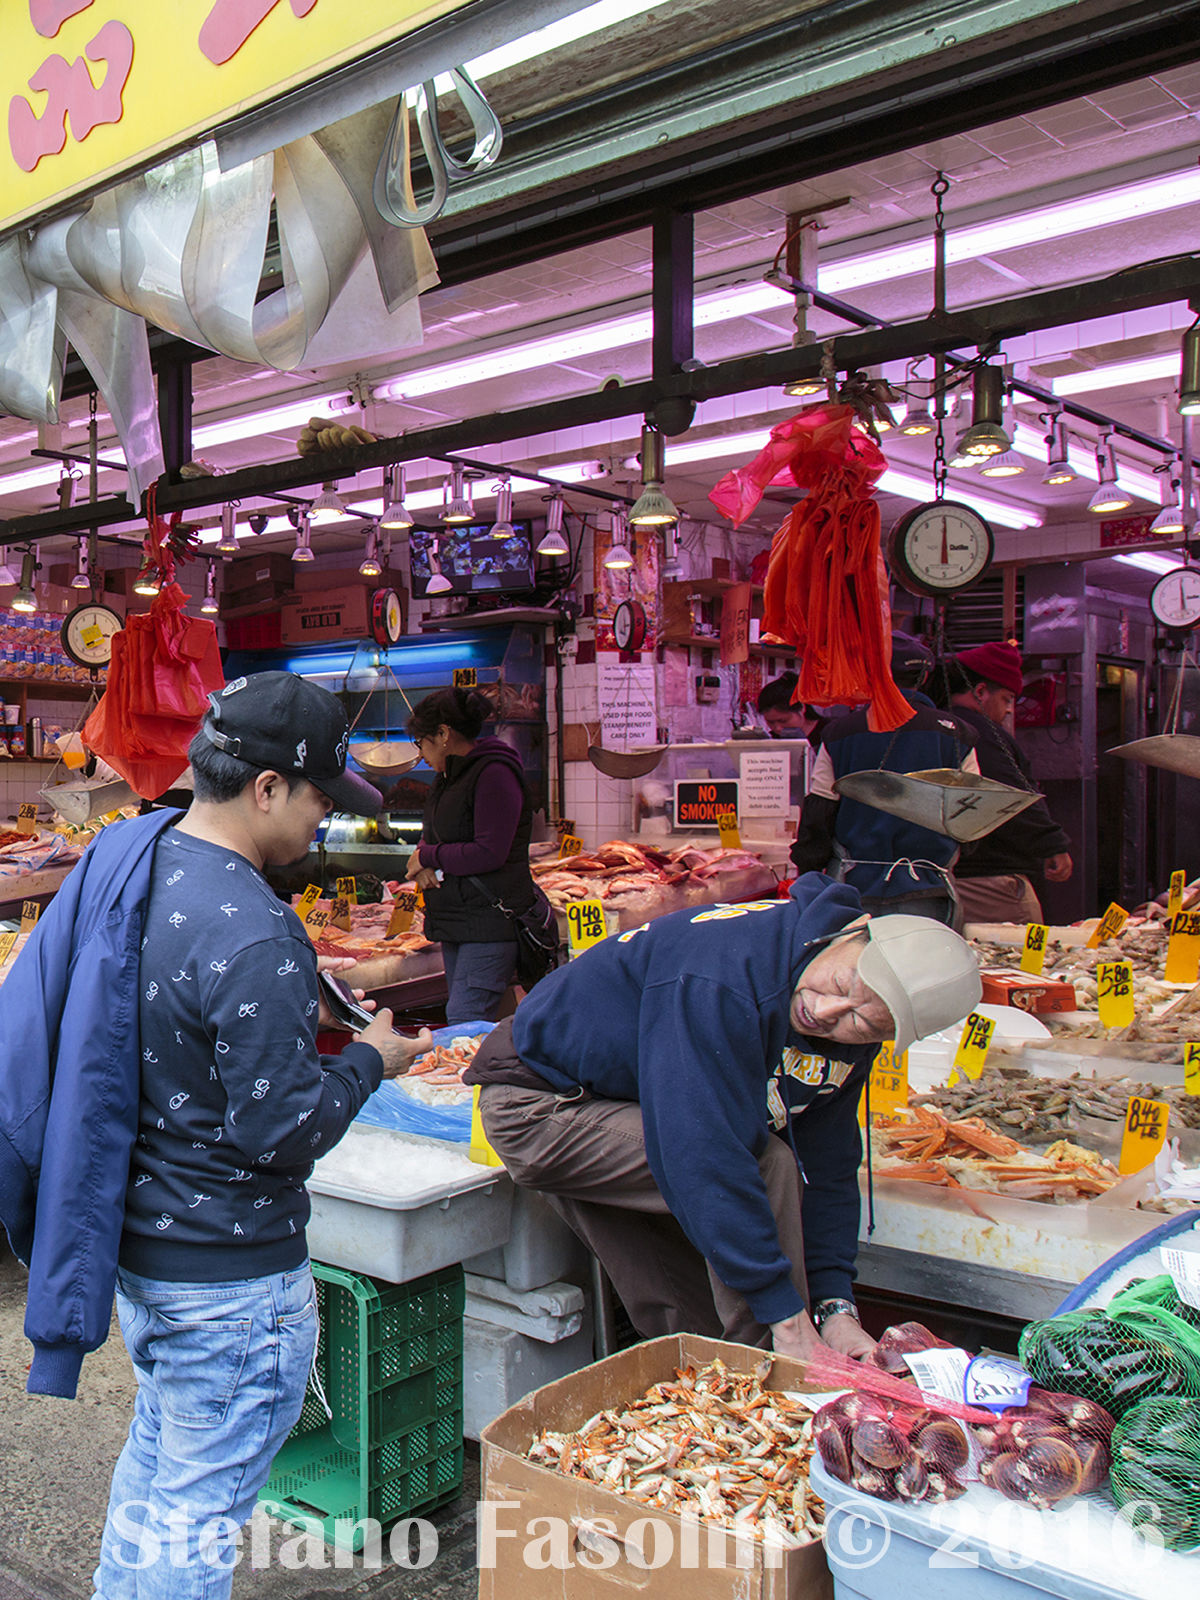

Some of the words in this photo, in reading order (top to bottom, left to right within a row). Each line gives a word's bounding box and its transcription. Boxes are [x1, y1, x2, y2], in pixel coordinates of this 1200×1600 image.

[698, 785, 717, 802] NO
[680, 803, 736, 820] SMOKING
[586, 925, 602, 937] LB
[972, 1035, 987, 1049] LB
